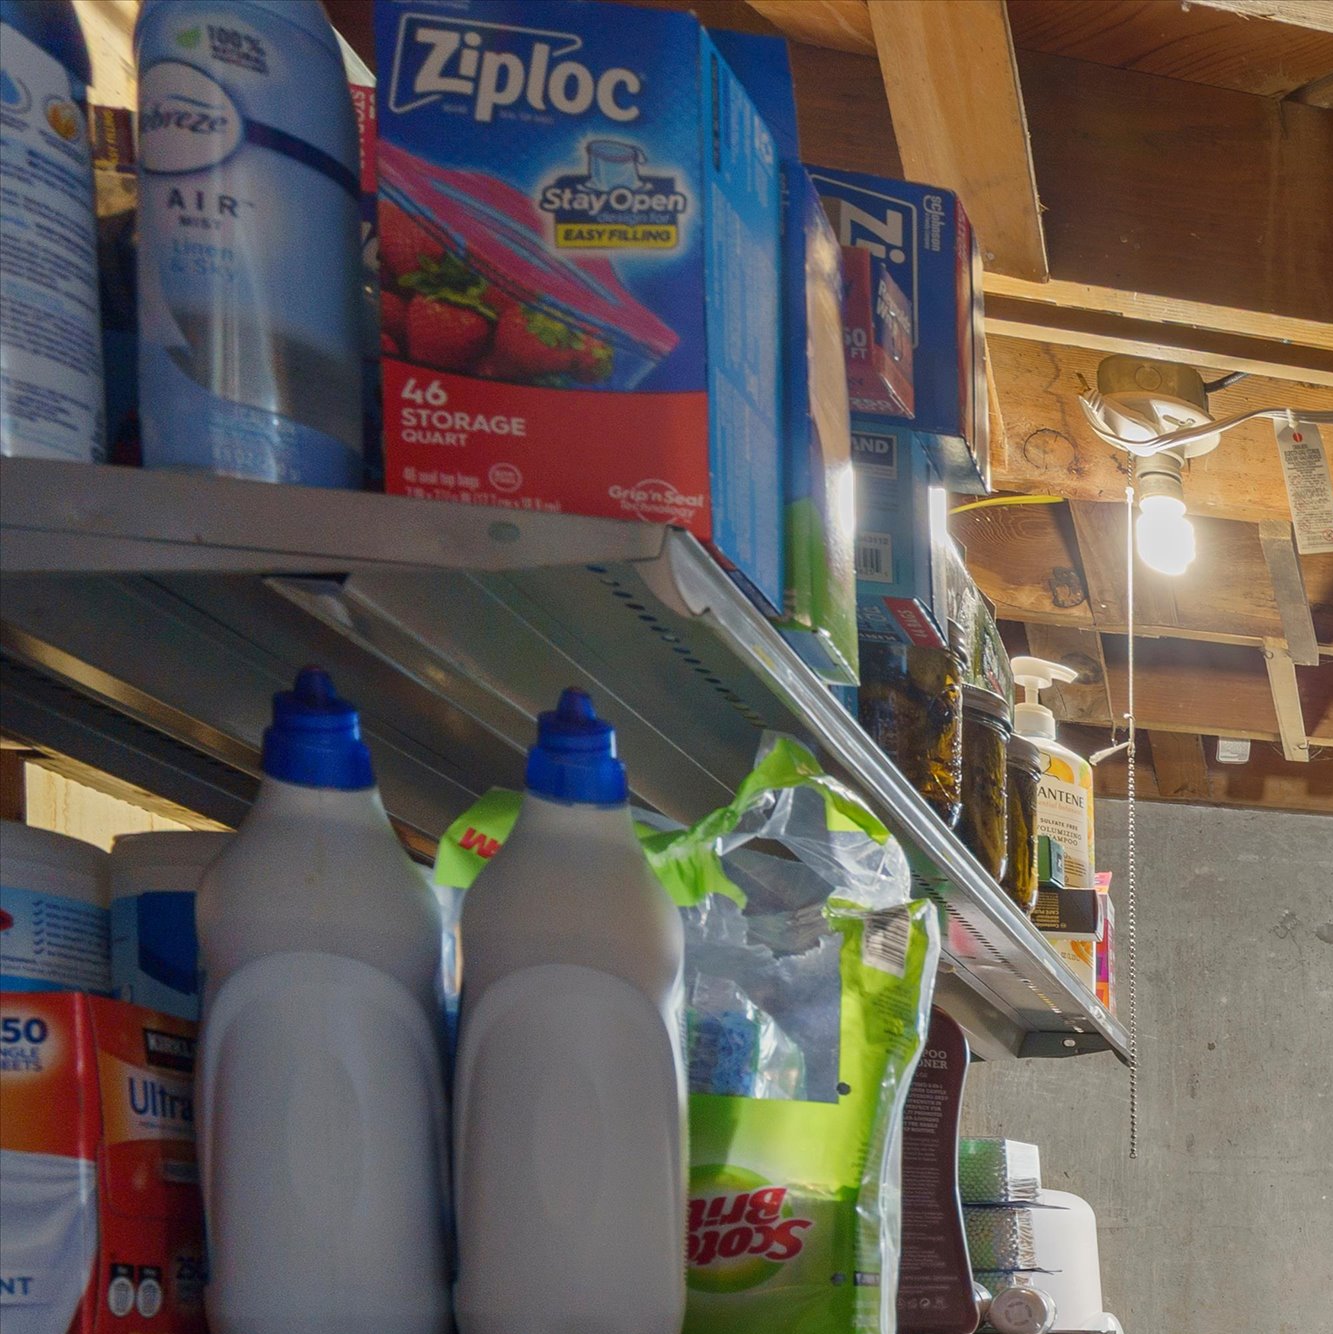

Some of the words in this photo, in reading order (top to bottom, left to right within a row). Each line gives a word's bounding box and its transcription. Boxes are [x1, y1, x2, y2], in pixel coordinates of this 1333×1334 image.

[414, 27, 641, 122] Ziploc
[167, 188, 239, 217] AIR
[563, 228, 606, 241] EASY
[610, 229, 672, 243] FILLING
[401, 378, 448, 405] 46
[401, 408, 527, 436] STORAGE
[401, 431, 468, 447] QUART
[1037, 786, 1085, 808] ANTENE
[1048, 834, 1079, 847] AMPOO
[129, 1077, 197, 1122] Ultra
[688, 1186, 789, 1232] Brit
[687, 1218, 814, 1267] Scot
